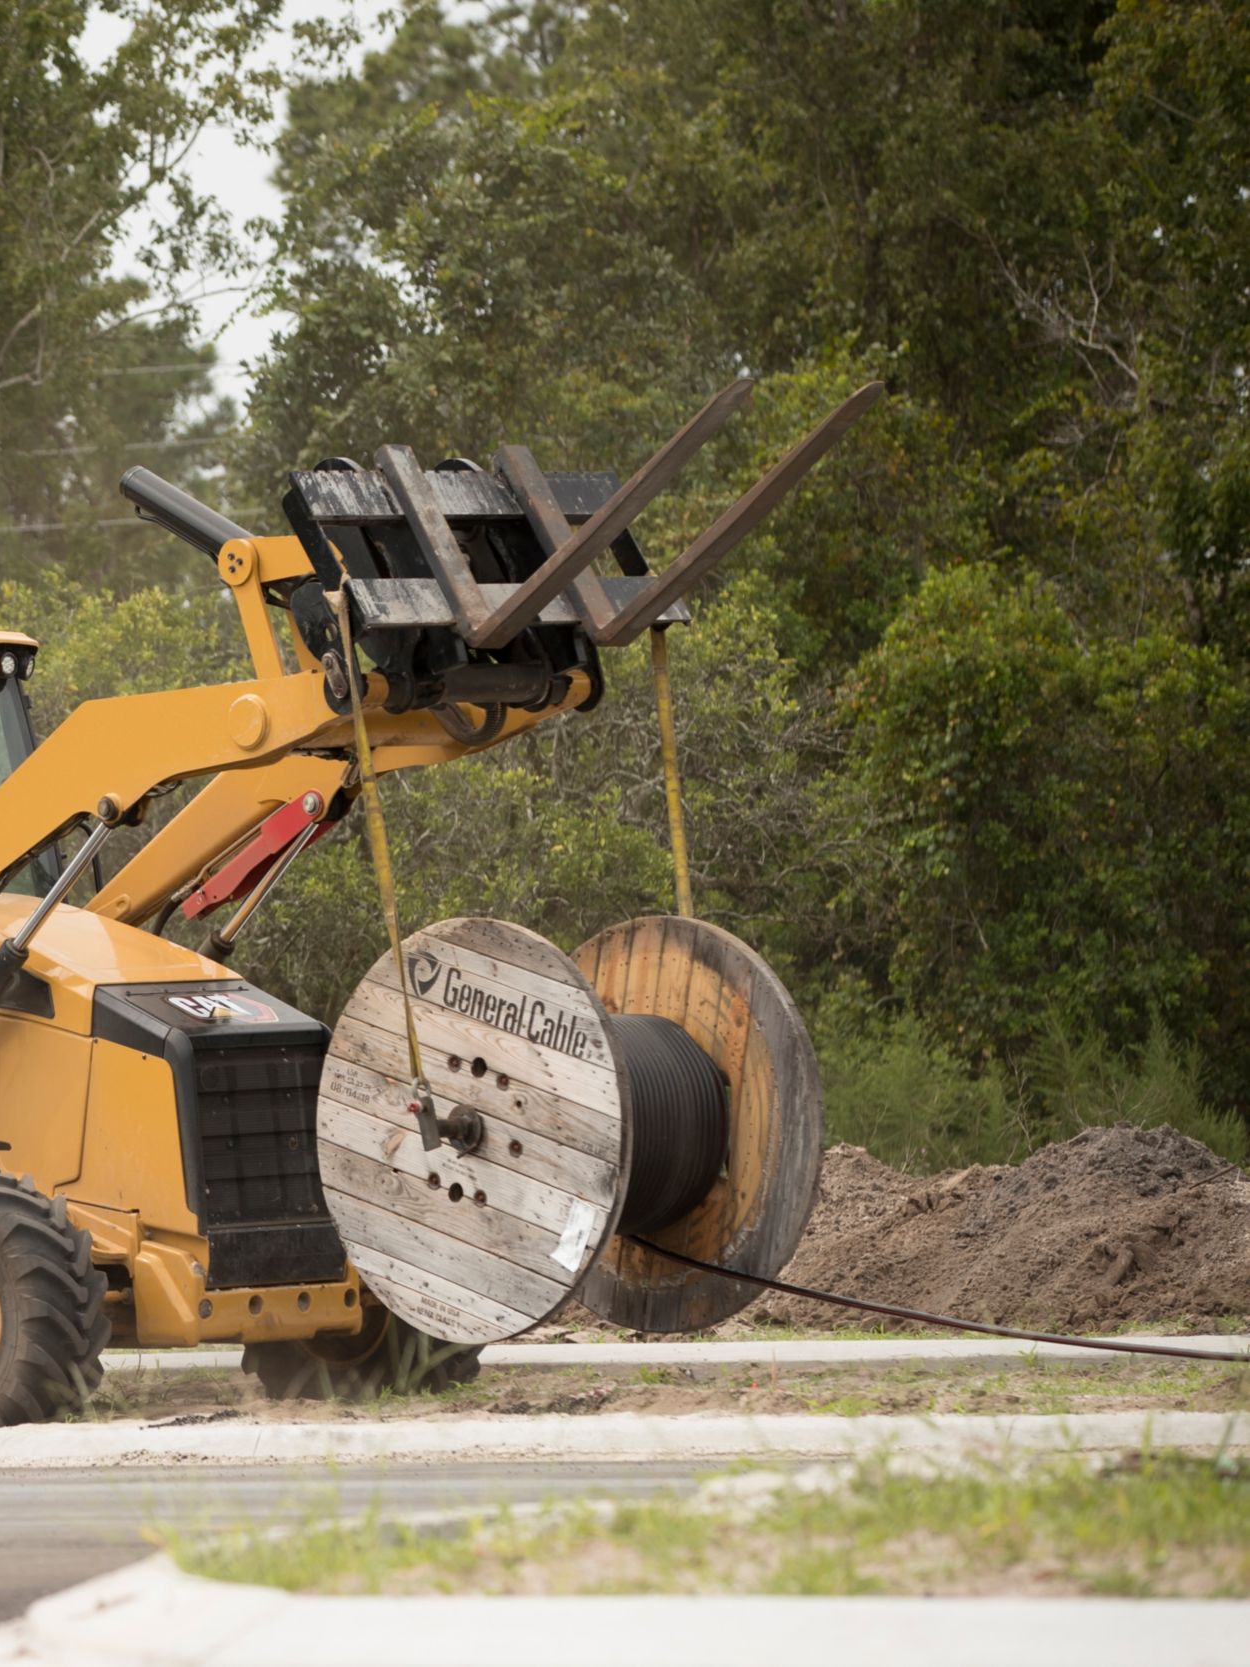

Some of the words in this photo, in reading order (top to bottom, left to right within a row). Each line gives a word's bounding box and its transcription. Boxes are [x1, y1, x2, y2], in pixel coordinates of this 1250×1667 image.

[168, 994, 253, 1019] CAT
[443, 967, 527, 1036] General
[527, 1000, 588, 1058] Cable
